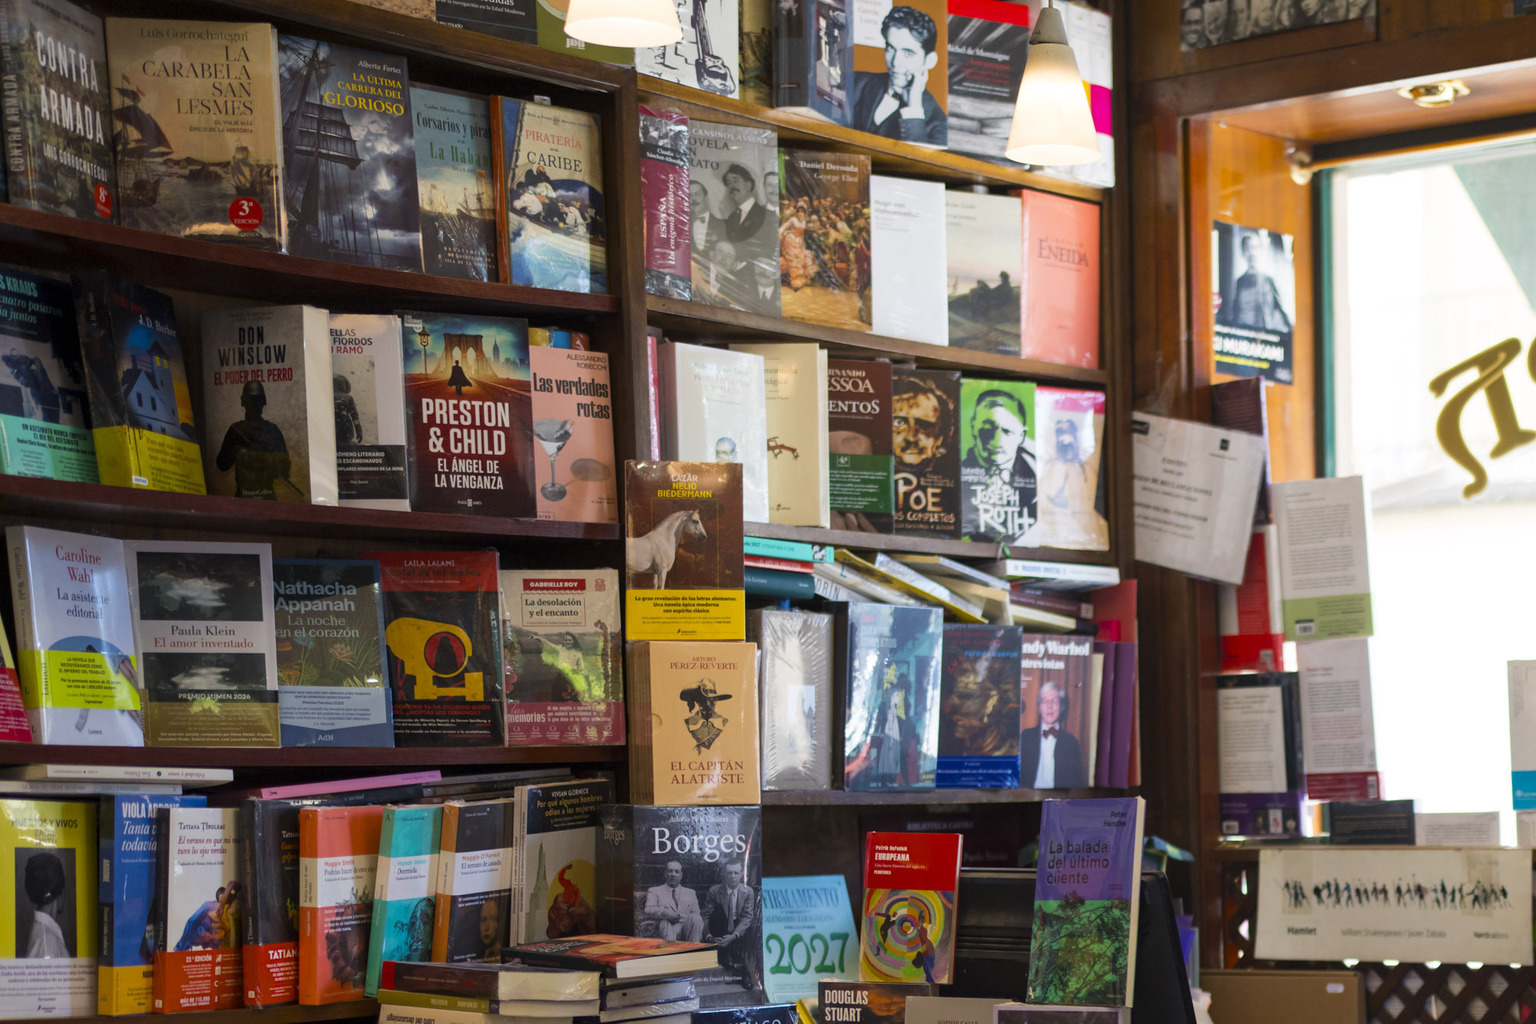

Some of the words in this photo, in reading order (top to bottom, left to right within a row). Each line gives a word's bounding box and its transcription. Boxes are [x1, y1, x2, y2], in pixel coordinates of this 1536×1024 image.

[37, 31, 98, 93] CONTRA
[225, 45, 250, 62] LA
[142, 61, 251, 80] CARABELA
[212, 82, 251, 98] SAN
[176, 98, 253, 116] LESMES
[324, 92, 404, 116] GLORIOSO
[40, 84, 104, 146] ARMADA
[416, 111, 461, 133] Corsarios
[462, 122, 467, 138] y
[525, 128, 582, 149] PIRATERÍA
[527, 151, 583, 173] CARIBE
[1037, 237, 1089, 268] ENEIDA
[238, 326, 264, 346] DON
[218, 345, 286, 367] WINSLOW
[566, 353, 607, 364] ALESSANDRO
[533, 372, 553, 393] Las
[555, 376, 609, 399] verdades
[421, 397, 510, 428] PRESTON
[576, 400, 610, 420] rotas
[429, 428, 445, 453] &
[449, 428, 506, 456] CHILD
[657, 490, 712, 498] BIEDERMANN
[895, 472, 943, 513] POE
[970, 483, 1020, 507] JOSEPH
[978, 502, 1037, 533] ROTH
[56, 545, 101, 565] Caroline
[273, 580, 356, 595] Nathacha
[275, 598, 355, 614] Appanah
[287, 615, 306, 626] La
[308, 615, 346, 626] noche
[171, 625, 202, 637] Paula
[205, 626, 235, 637] Klein
[154, 638, 166, 648] El
[169, 640, 198, 648] amor
[201, 639, 254, 649] inventado
[318, 733, 335, 741] AdN
[671, 761, 686, 771] EL
[689, 759, 744, 771] CAPITÁN
[671, 774, 744, 785] ALATRISTE
[652, 828, 746, 863] Borges
[875, 853, 910, 862] EUROPEANA
[1287, 926, 1317, 936] Hamlet
[765, 932, 849, 975] 2027
[825, 990, 868, 1005] DOUGLAS
[825, 1007, 862, 1022] STUART
